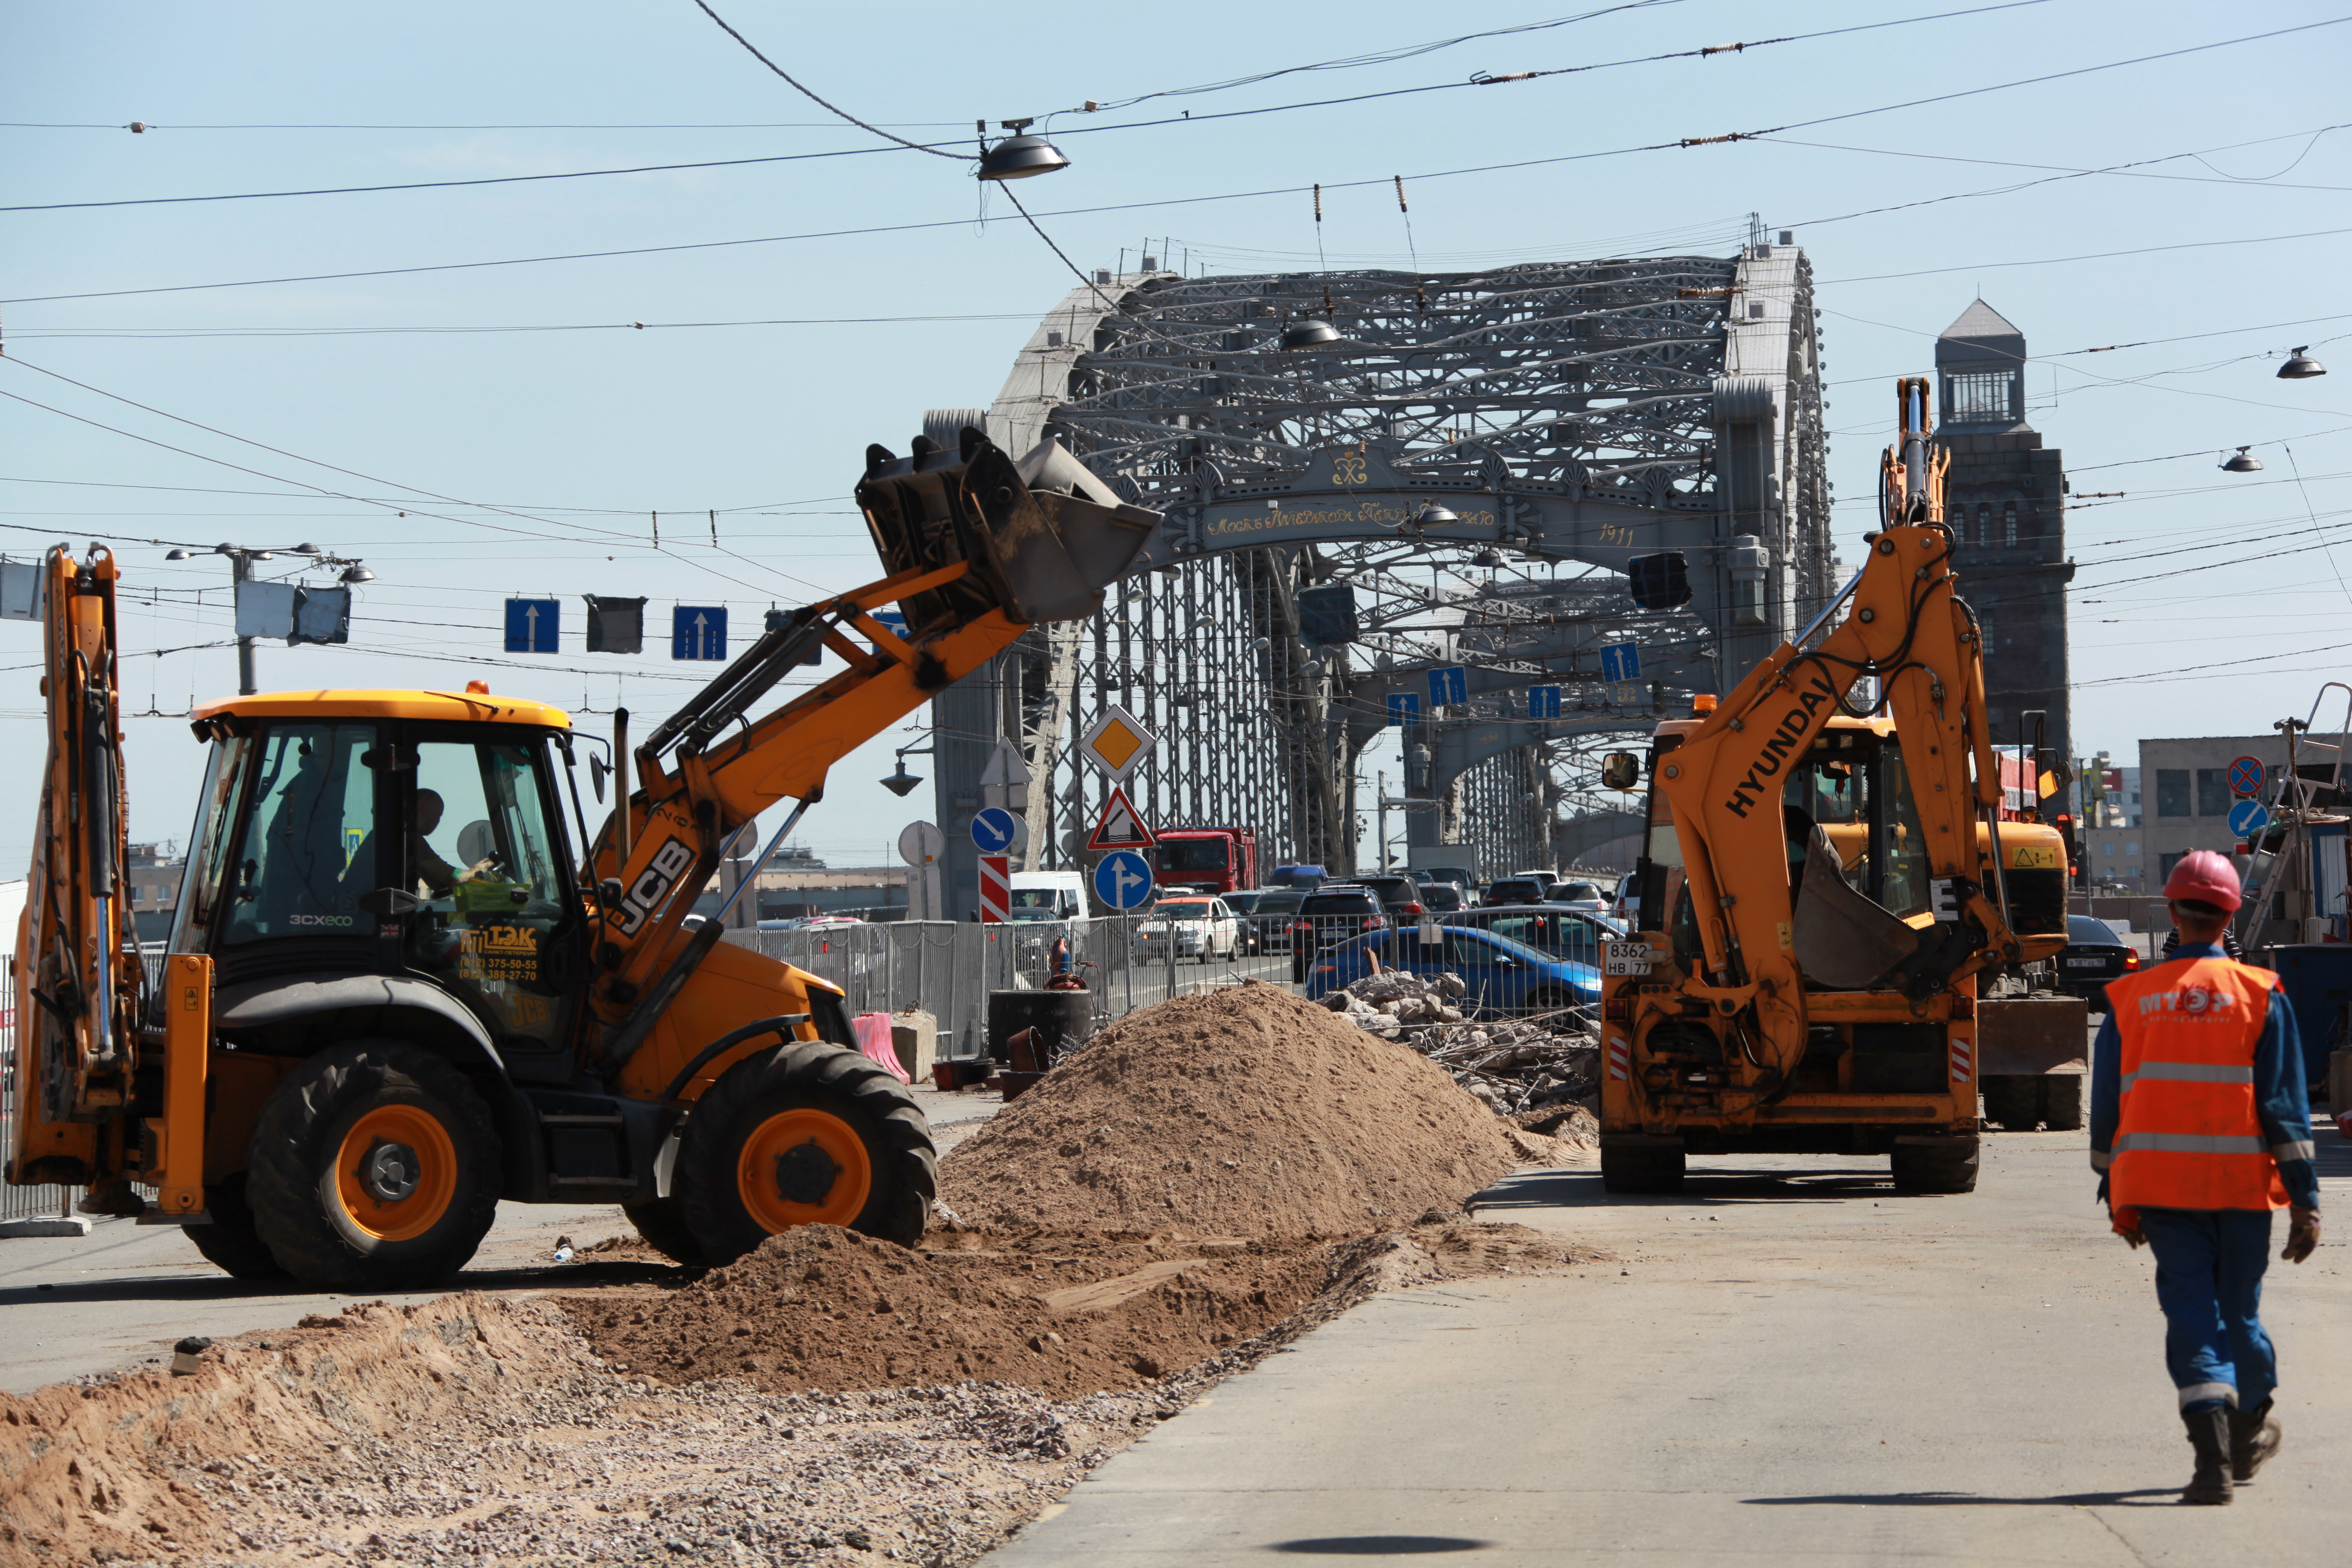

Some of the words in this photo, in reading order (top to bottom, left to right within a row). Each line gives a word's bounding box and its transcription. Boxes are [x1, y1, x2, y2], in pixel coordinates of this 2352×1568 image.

[1599, 524, 1633, 547] 1911
[1725, 677, 1833, 819] HYUNDAI
[622, 841, 691, 934] JCB
[289, 915, 353, 926] 3CXeco
[1611, 944, 1647, 958] 8362
[460, 958, 485, 968] (812)
[488, 958, 537, 969] 375-50-55
[1635, 963, 1649, 974] 77
[459, 969, 485, 979] (812)
[488, 970, 536, 980] 388-27-70
[2139, 989, 2233, 1016] МТЭР
[512, 996, 547, 1026] JCB
[2142, 1015, 2231, 1027] СНКТ-ПЕТЕРБУРГ
